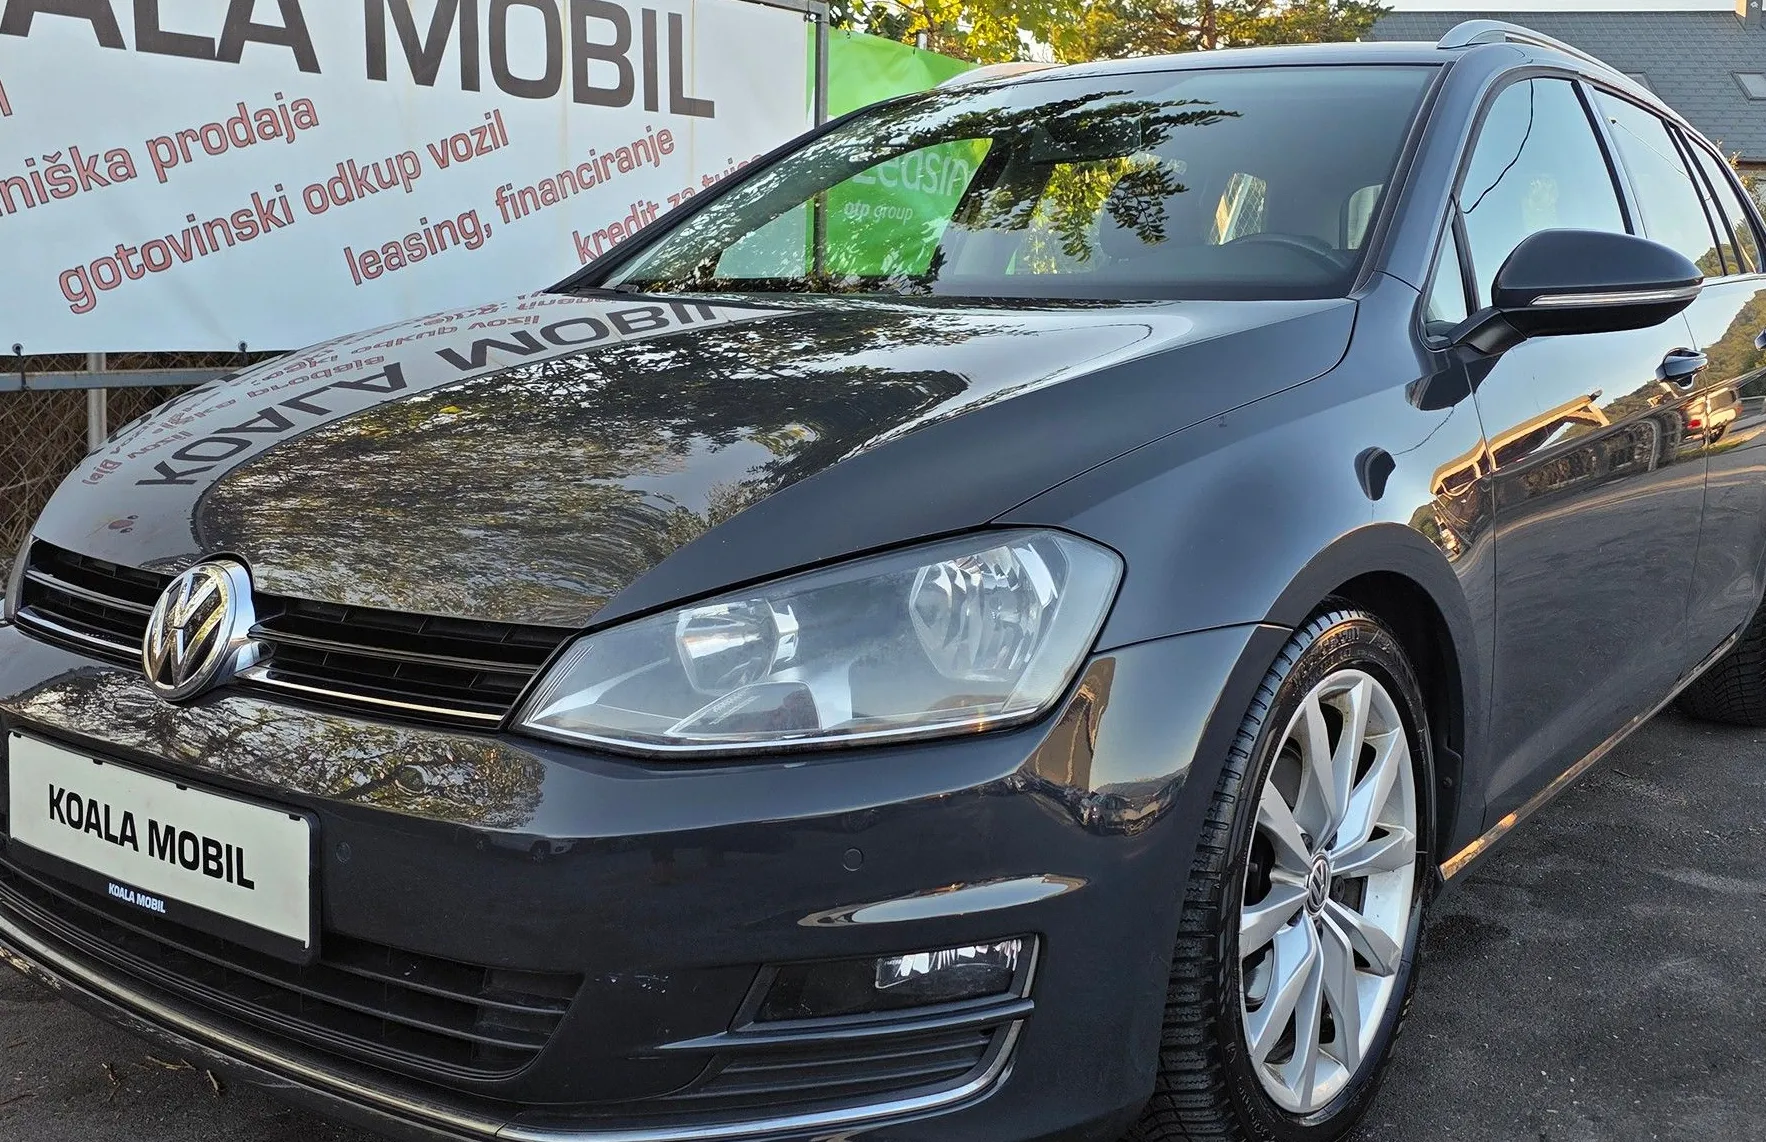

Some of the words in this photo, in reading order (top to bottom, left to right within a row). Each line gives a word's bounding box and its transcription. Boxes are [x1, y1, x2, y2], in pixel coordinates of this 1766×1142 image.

[364, 0, 715, 119] MOBIL
[0, 145, 138, 217] niška
[145, 92, 320, 184] prodaja
[343, 209, 493, 286] leasing,
[495, 125, 675, 224] financiranje
[58, 184, 295, 315] gotovinski
[302, 150, 422, 215] odkup
[427, 109, 510, 171] vozil
[572, 200, 660, 266] kredit
[844, 199, 871, 222] otp
[872, 203, 914, 225] group
[48, 783, 139, 852] KOALA
[148, 818, 255, 890] MOBIL
[108, 882, 136, 904] KOALA
[136, 892, 166, 914] MOBIL
